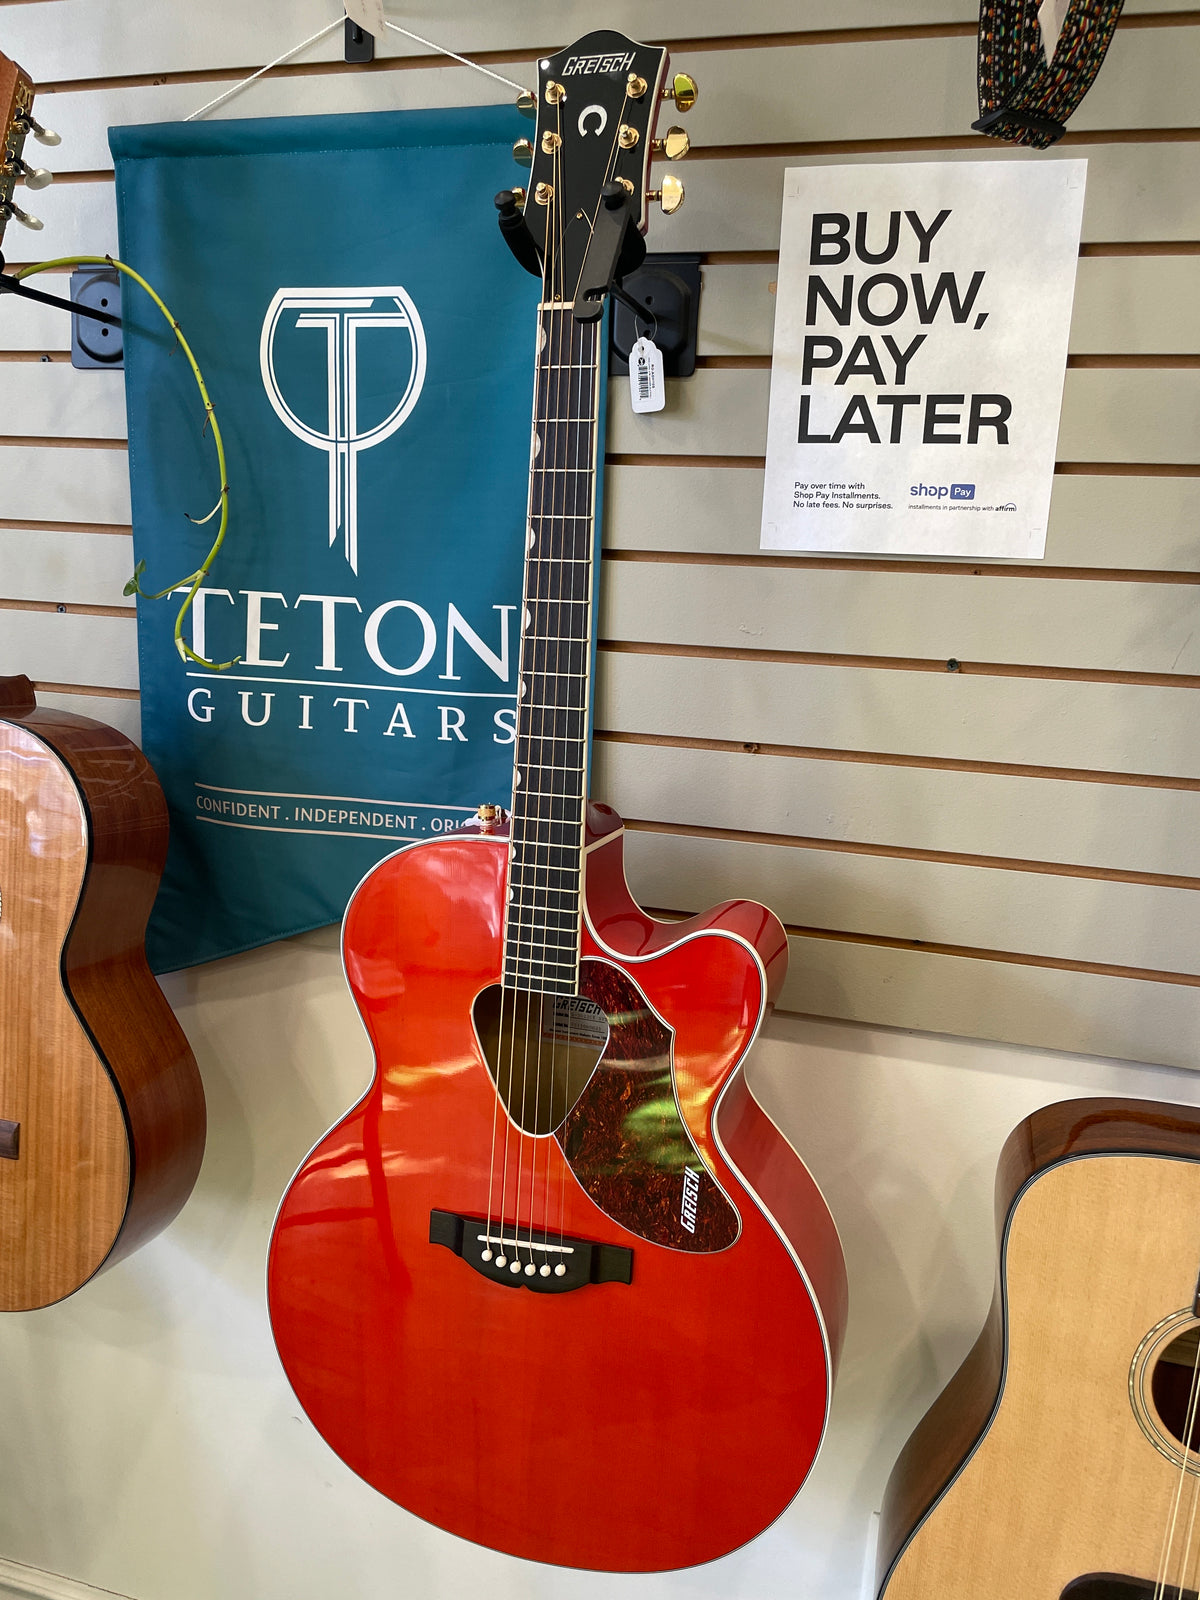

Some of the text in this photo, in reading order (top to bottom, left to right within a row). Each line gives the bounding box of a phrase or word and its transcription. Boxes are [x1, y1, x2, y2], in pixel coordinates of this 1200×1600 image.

[561, 52, 636, 76] GRETSCH
[809, 209, 952, 266] BUY
[805, 270, 990, 330] NOW,
[801, 333, 928, 386] PAY
[797, 393, 1012, 445] LATER
[793, 491, 881, 500] Shop Pay Installments.
[793, 500, 804, 508] No
[822, 501, 840, 509] fees.
[842, 501, 854, 509] No
[856, 502, 893, 510] surprises.
[794, 481, 809, 490] Pay
[829, 482, 846, 490] time
[848, 482, 866, 490] with
[910, 483, 972, 499] shop Pay
[995, 503, 1016, 512] affirm
[167, 587, 517, 683] TETON
[187, 687, 517, 746] GUITARS
[196, 795, 280, 821] CONFIDENT
[294, 807, 417, 831] INDEPENDENT
[680, 1165, 700, 1234] GRETSCH
